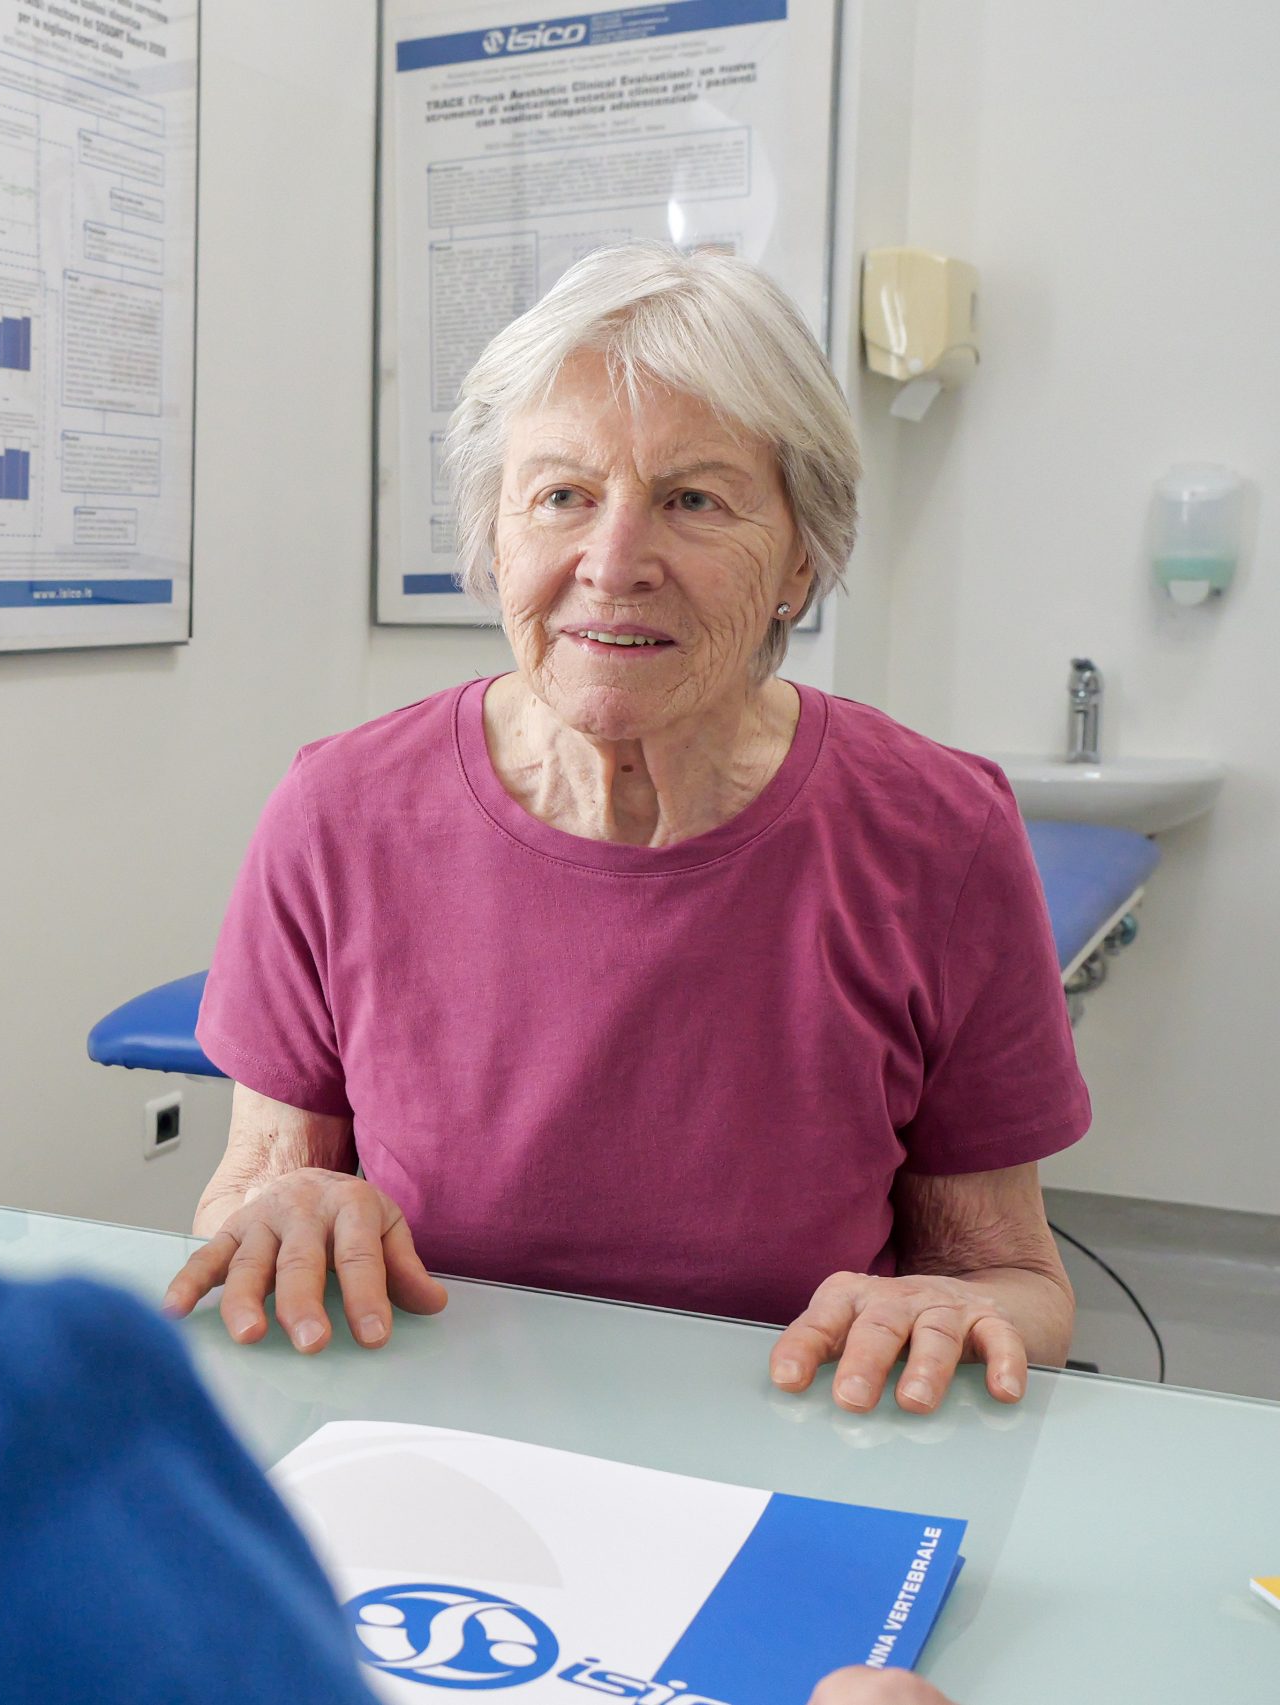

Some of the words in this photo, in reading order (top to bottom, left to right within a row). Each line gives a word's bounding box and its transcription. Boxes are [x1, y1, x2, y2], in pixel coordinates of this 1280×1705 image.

[506, 23, 587, 51] isico
[425, 107, 484, 123] strumento
[489, 104, 499, 115] di
[503, 97, 569, 112] valutazione
[574, 90, 623, 104] estetica
[628, 84, 668, 97] clinica
[672, 82, 693, 95] per
[705, 73, 757, 89] pazienti
[426, 96, 464, 110] TRACE
[510, 84, 567, 99] Aesthetic
[572, 77, 616, 91] Clinical
[699, 67, 714, 76] un
[719, 62, 757, 73] nuovo
[33, 588, 92, 599] www.isico.it
[883, 1526, 942, 1631] VERTEBRALE
